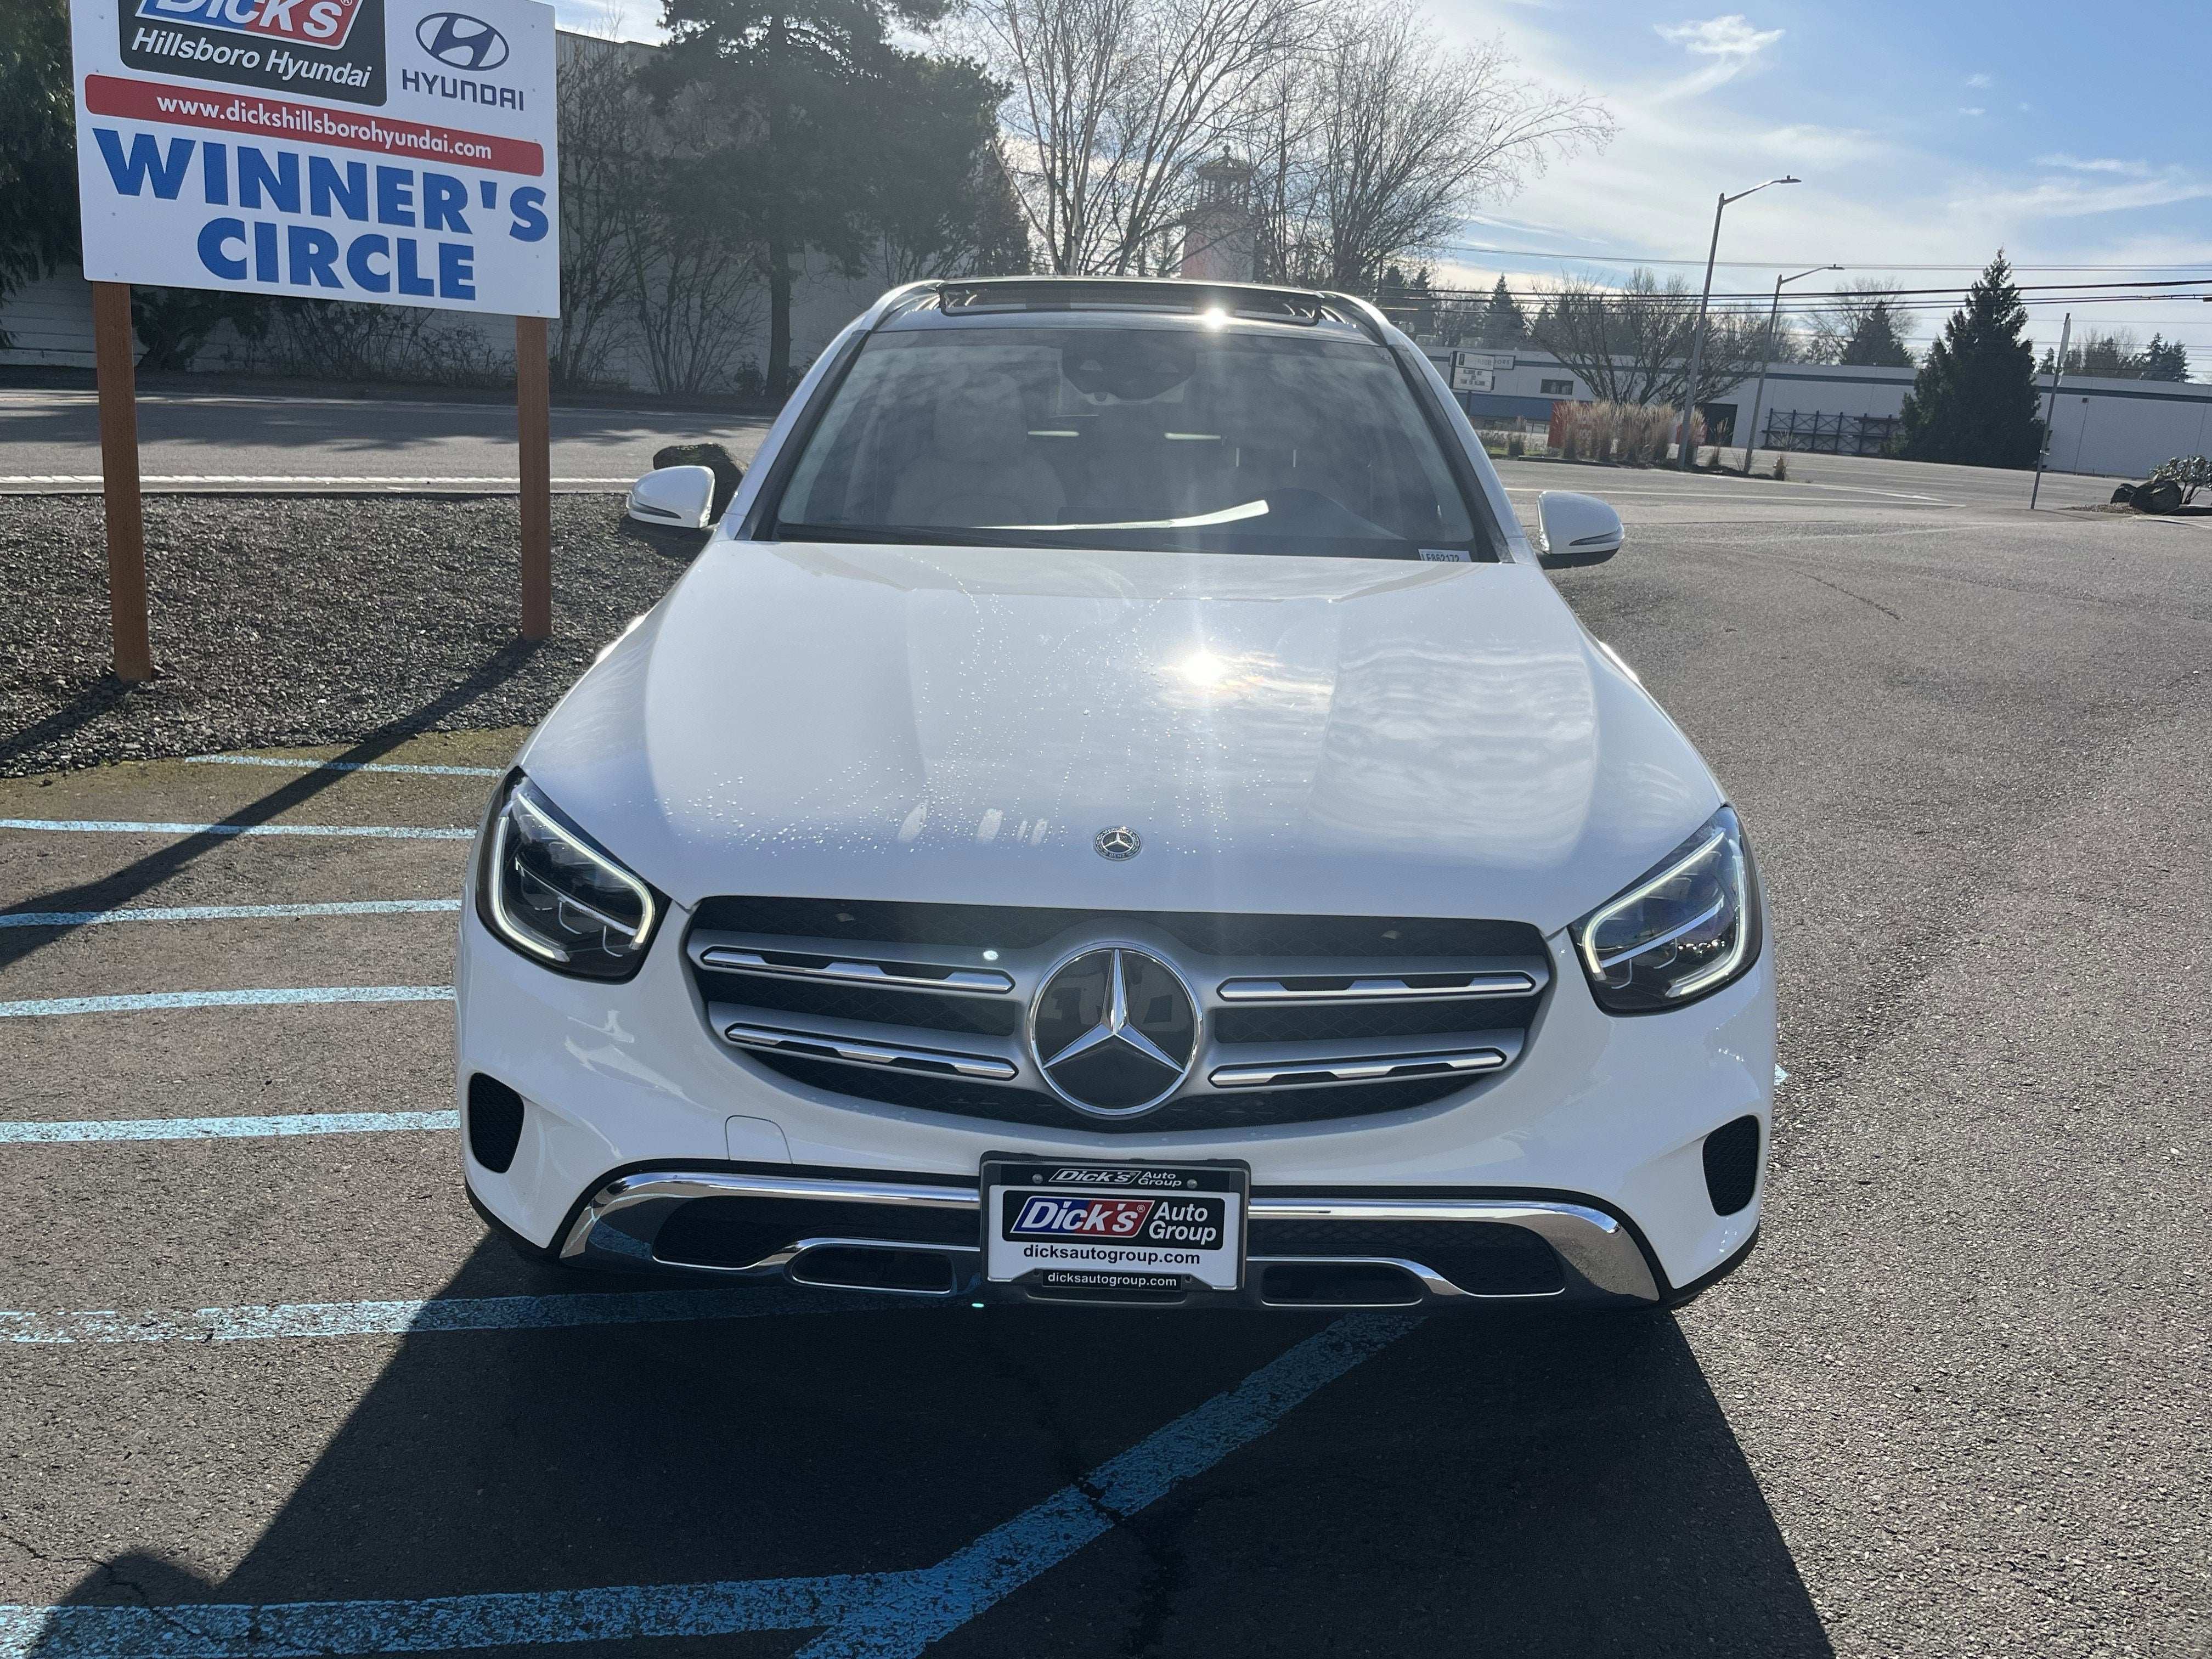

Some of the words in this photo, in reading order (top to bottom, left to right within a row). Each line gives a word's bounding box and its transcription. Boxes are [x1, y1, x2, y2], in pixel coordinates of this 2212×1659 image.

[156, 0, 342, 38] cks
[132, 27, 260, 69] Hillsboro
[266, 49, 373, 88] Hyundai
[402, 69, 524, 111] HYUNDAI
[156, 94, 493, 160] www.dickshillsborohyundai.com
[92, 128, 549, 242] WINNER'S
[197, 217, 476, 301] CIRCLE
[1056, 1170, 1131, 1182] Dick's
[1138, 1178, 1182, 1188] Group
[1142, 1171, 1176, 1180] Auto
[1021, 1200, 1136, 1233] Dick's
[1153, 1201, 1208, 1222] Auto
[1149, 1220, 1217, 1245] Group
[1023, 1244, 1200, 1265] dicksautogroup.com
[1047, 1271, 1177, 1287] dicksautogroup.com
